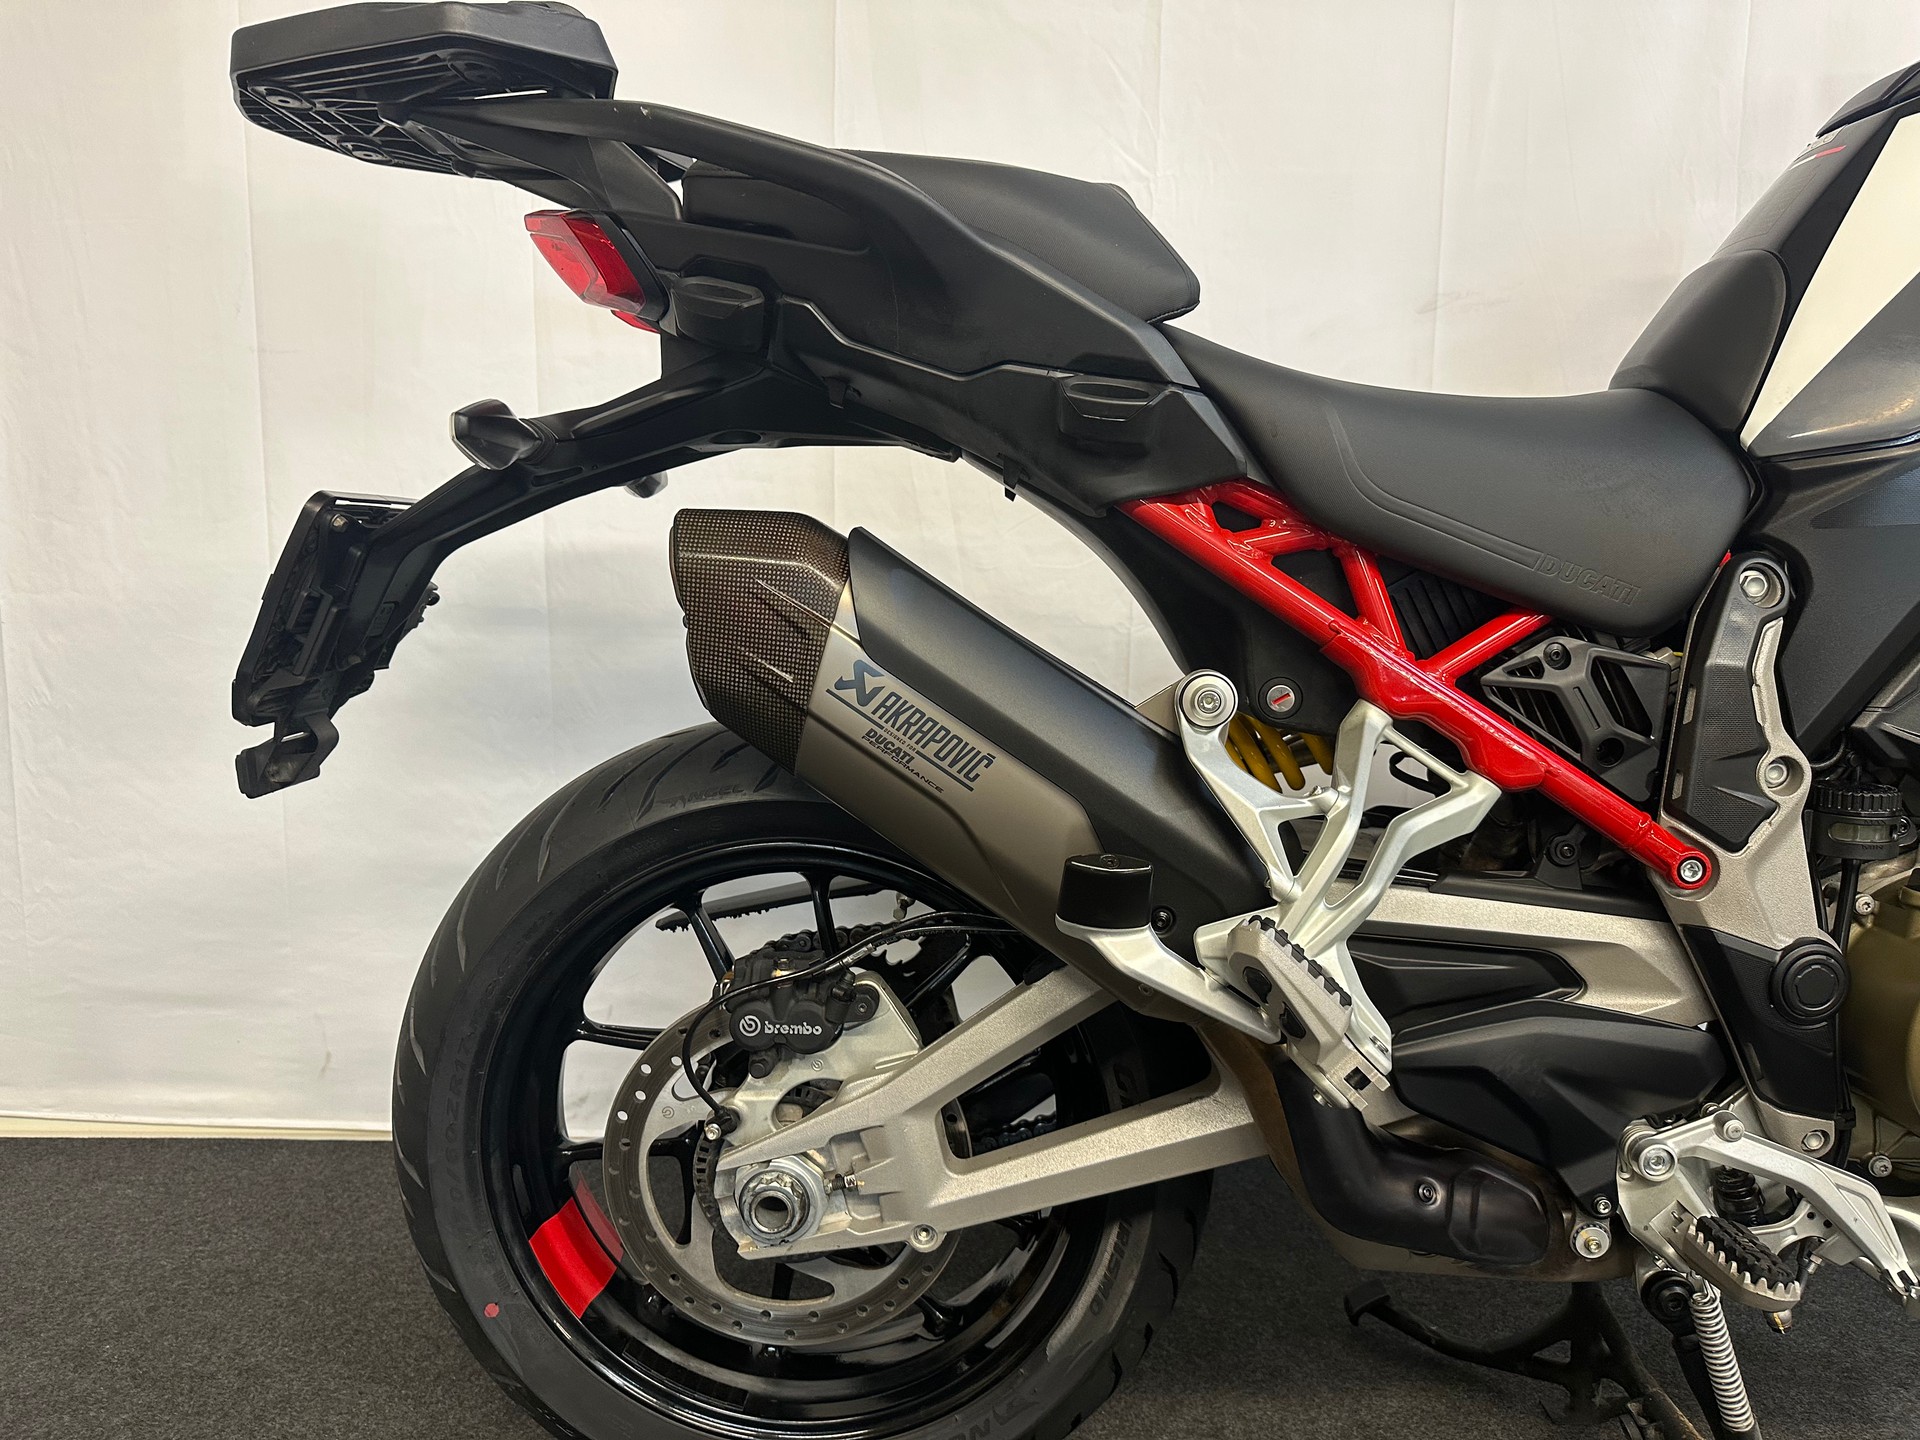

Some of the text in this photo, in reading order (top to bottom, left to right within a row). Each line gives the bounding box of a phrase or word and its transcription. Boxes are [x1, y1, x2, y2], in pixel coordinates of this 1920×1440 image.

[1536, 553, 1641, 606] DUCATI
[864, 728, 915, 765] DUCATI
[883, 727, 907, 745] DESIGNED
[861, 735, 944, 793] PERFORMANCE
[764, 1020, 823, 1036] brembo
